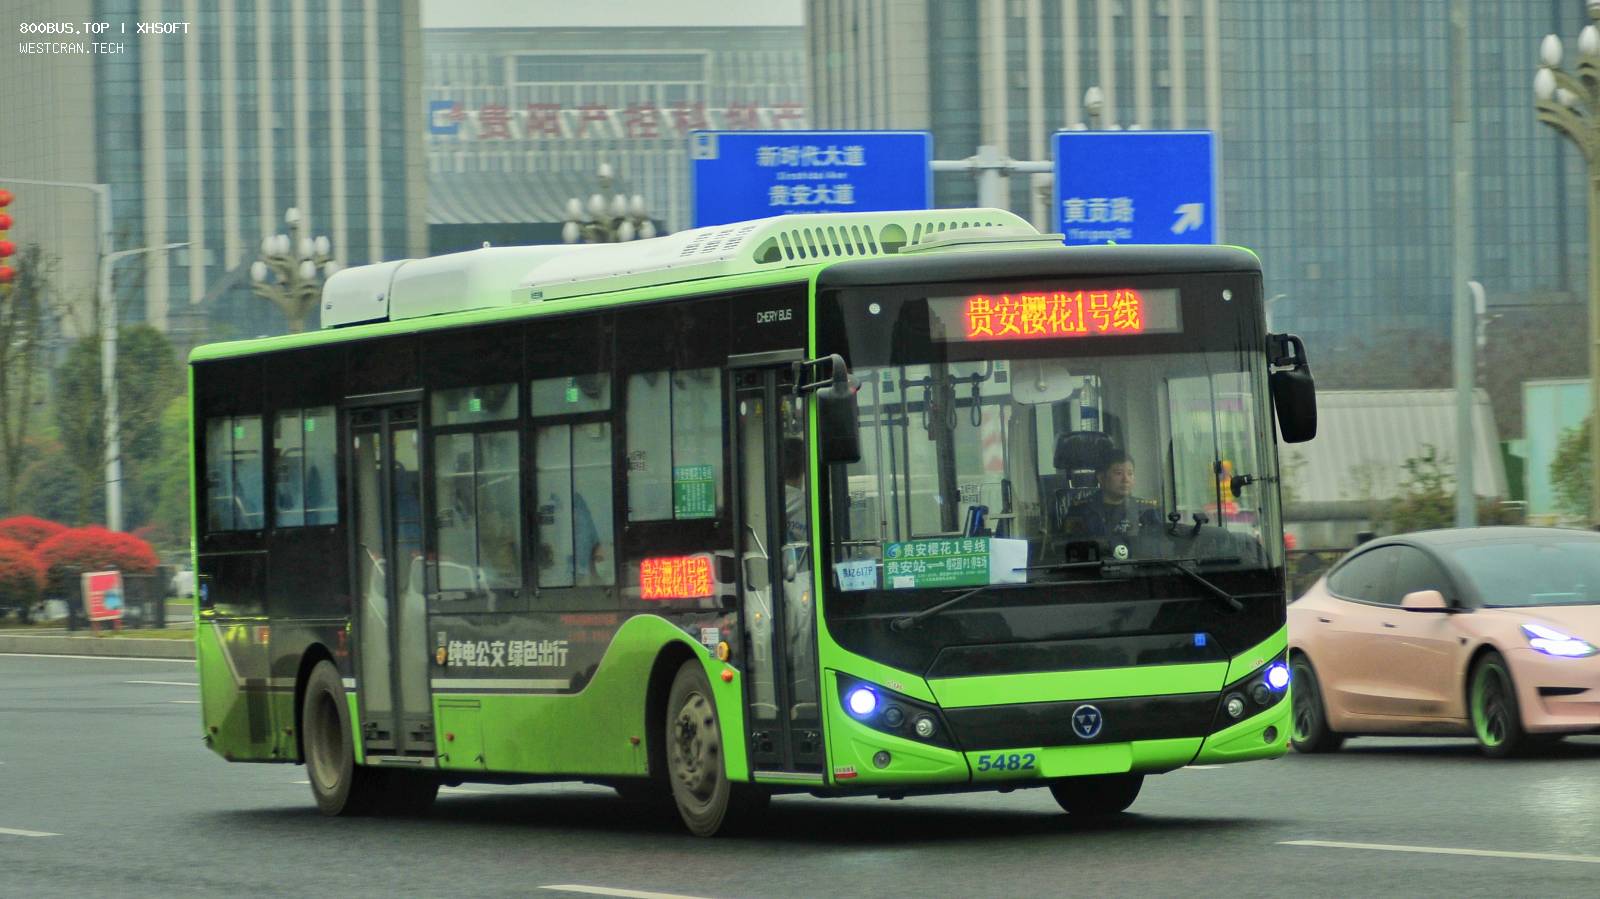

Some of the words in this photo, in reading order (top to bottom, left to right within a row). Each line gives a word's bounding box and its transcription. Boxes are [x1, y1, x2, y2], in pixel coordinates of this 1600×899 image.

[756, 145, 866, 166] 新时代大道
[768, 183, 856, 206] 贵安大道
[756, 310, 778, 323] CHERY
[778, 308, 792, 321] BUS
[967, 290, 1140, 337] 贵安樱花1号线
[903, 539, 986, 558] 贵安樱花1号线
[641, 557, 710, 598] 贵安樱花1号线
[887, 560, 926, 575] 贵安站
[447, 640, 506, 667] 纯电公交
[508, 640, 568, 667] 绿色出行
[977, 752, 1036, 772] 5482
